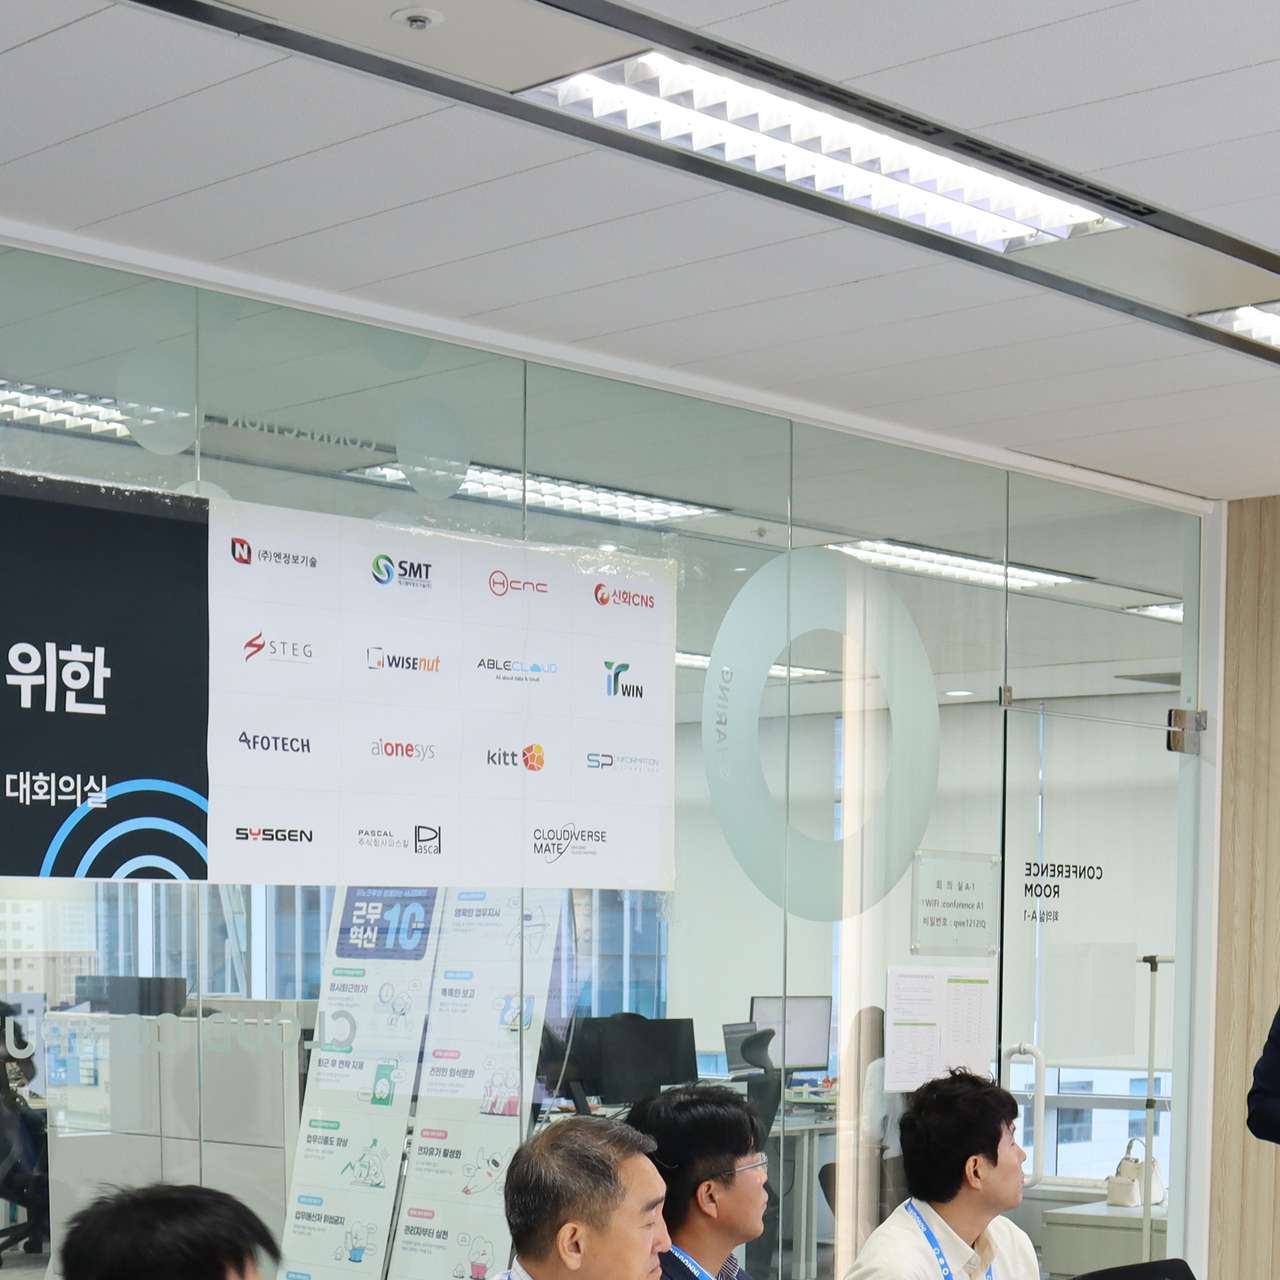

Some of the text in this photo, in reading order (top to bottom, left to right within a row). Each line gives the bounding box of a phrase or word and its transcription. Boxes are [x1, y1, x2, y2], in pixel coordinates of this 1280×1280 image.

[258, 550, 318, 568] (주)엔정보기술
[398, 561, 432, 580] SMT
[611, 590, 655, 608] 신화CNS
[269, 640, 313, 658] STEG
[5, 640, 112, 716] 위한
[371, 738, 435, 762] aionesys
[487, 748, 518, 766] kitt
[5, 770, 108, 810] 대회의실
[235, 827, 313, 842] SYSGEN
[358, 829, 394, 838] PASCAL
[533, 842, 563, 854] MATE
[351, 901, 383, 924] 근무
[349, 925, 378, 949] 혁신
